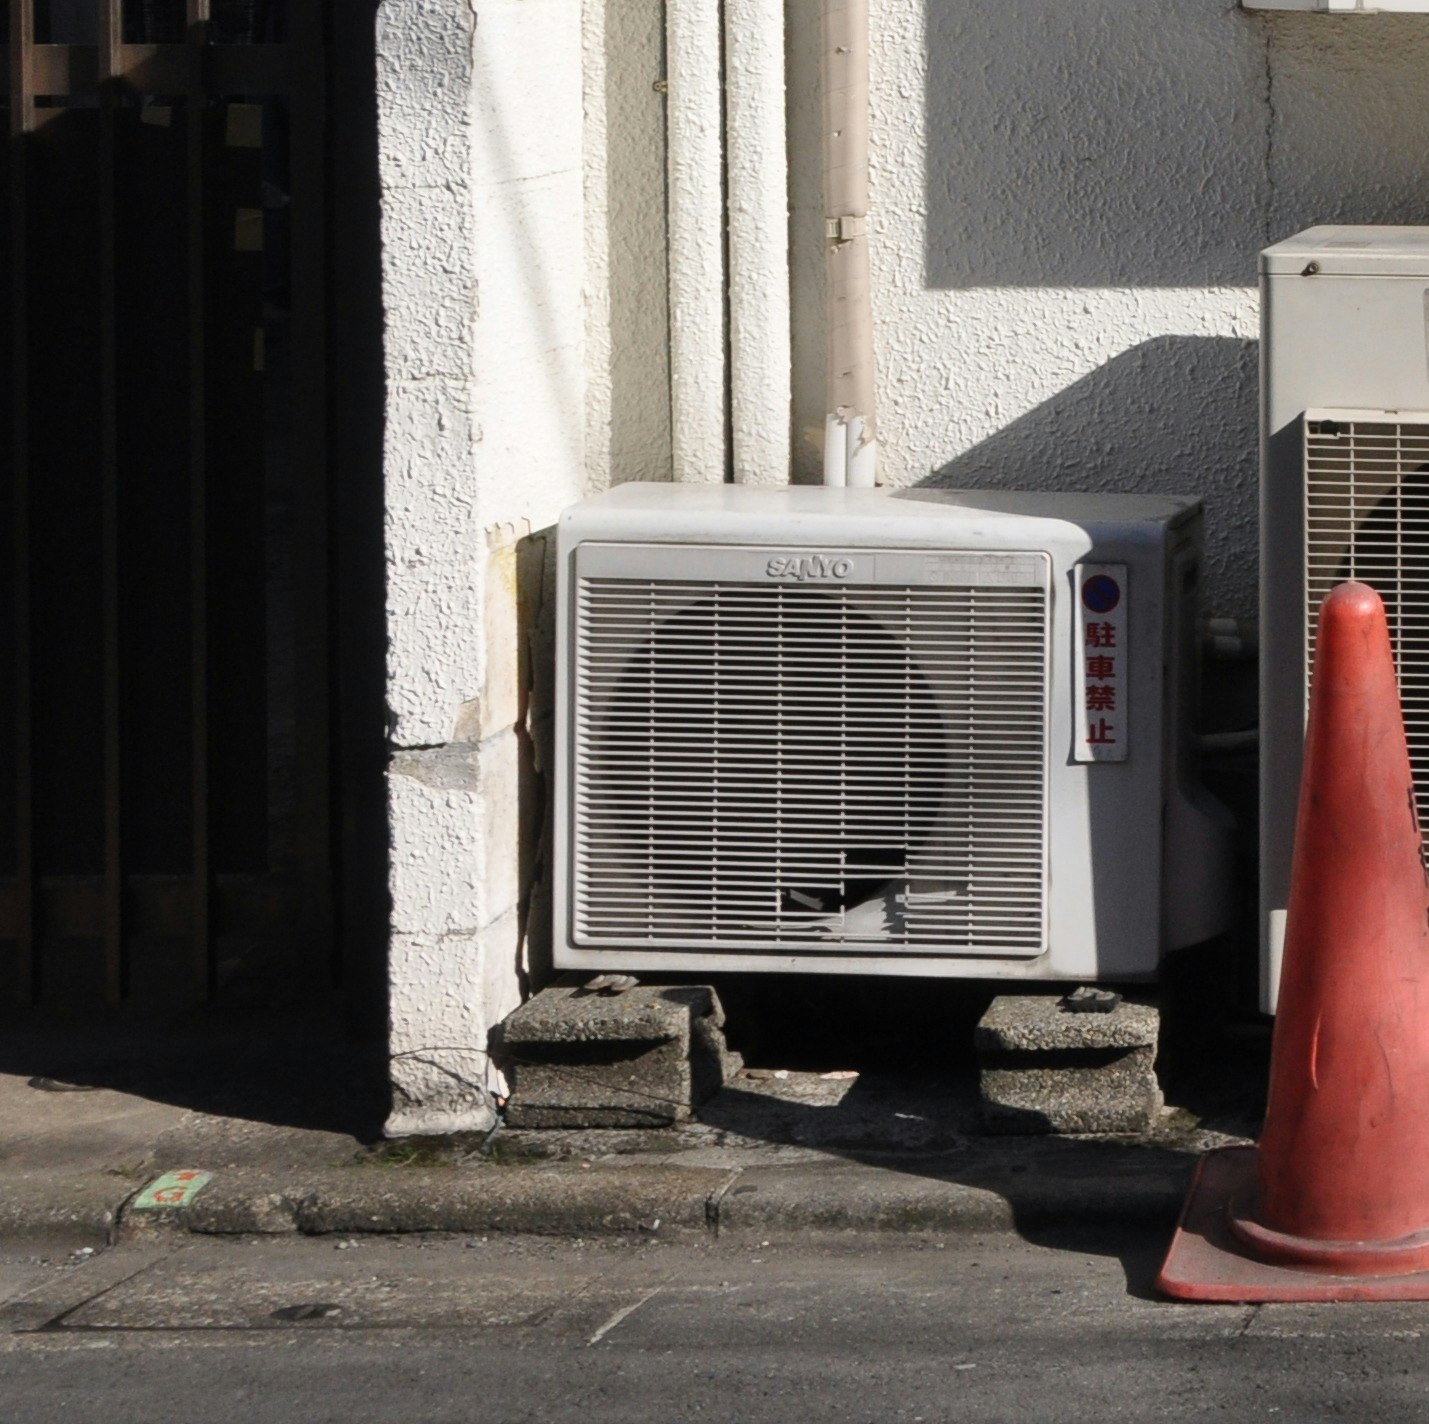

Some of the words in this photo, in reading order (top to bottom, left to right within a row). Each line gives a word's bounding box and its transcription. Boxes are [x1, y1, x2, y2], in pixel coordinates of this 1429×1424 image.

[766, 554, 854, 580] SANYO
[1084, 621, 1117, 745] 駐車禁止
